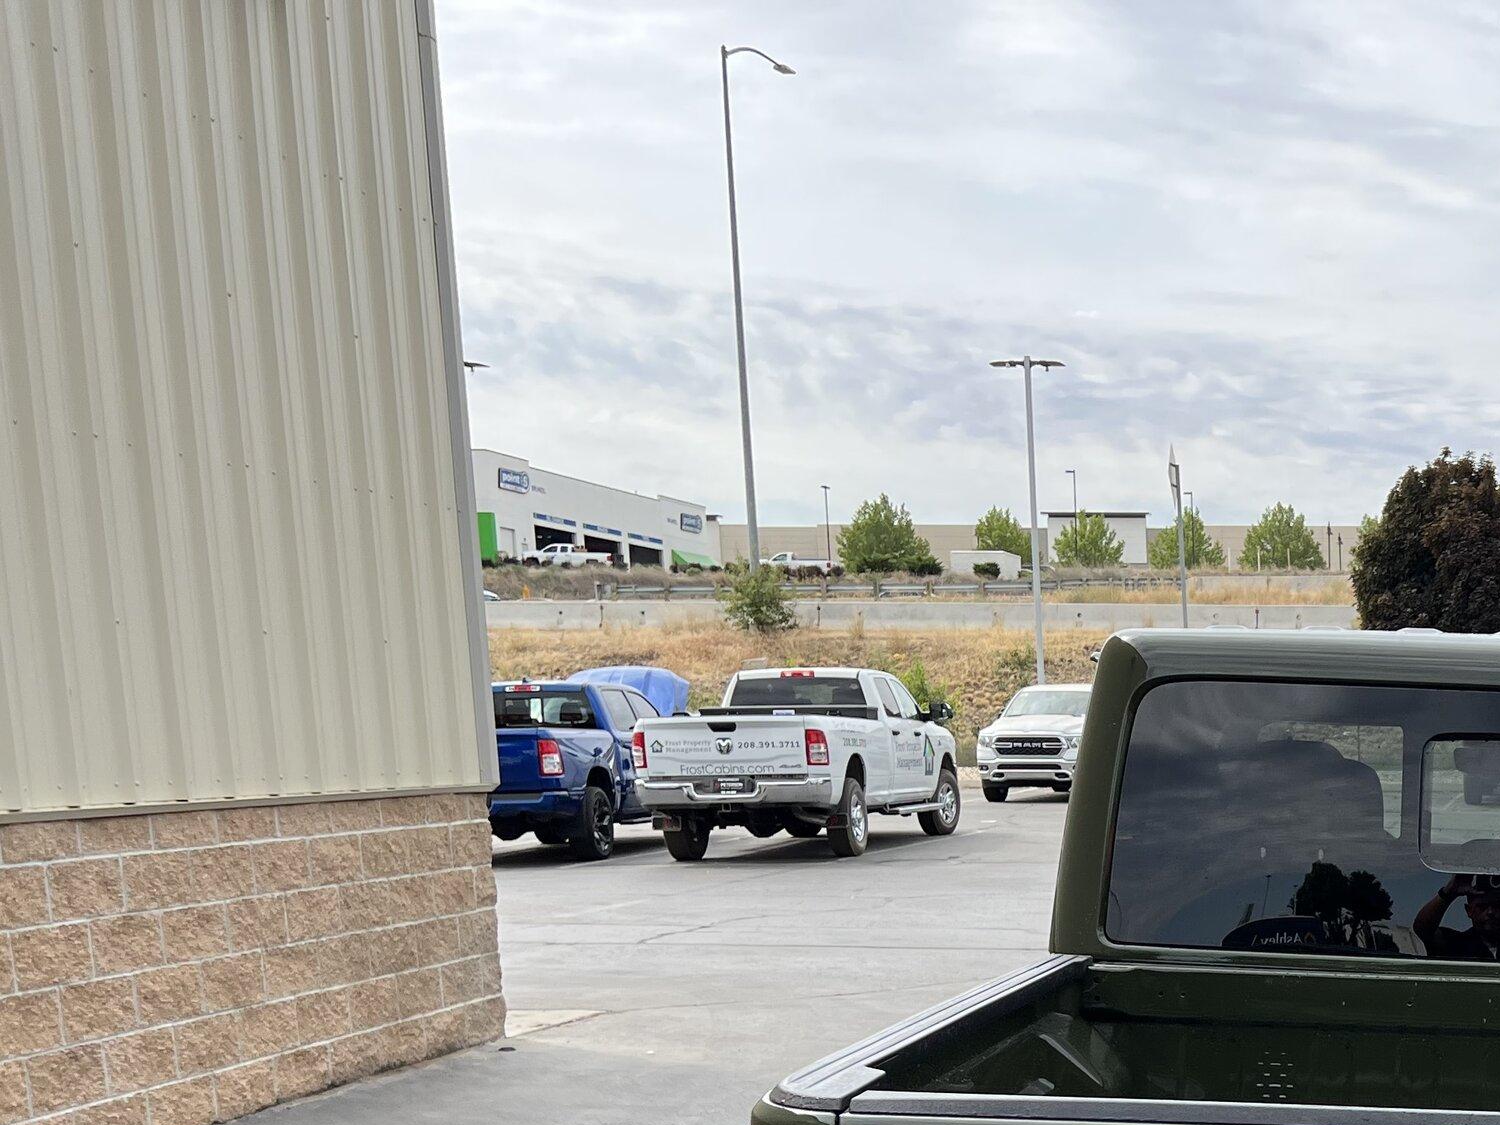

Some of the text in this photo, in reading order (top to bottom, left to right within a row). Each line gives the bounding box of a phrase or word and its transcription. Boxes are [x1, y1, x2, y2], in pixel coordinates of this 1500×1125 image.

[683, 740, 711, 748] Property
[737, 740, 800, 749] 208.391.3711
[665, 746, 712, 754] Management
[680, 764, 775, 775] FrostCabins.com
